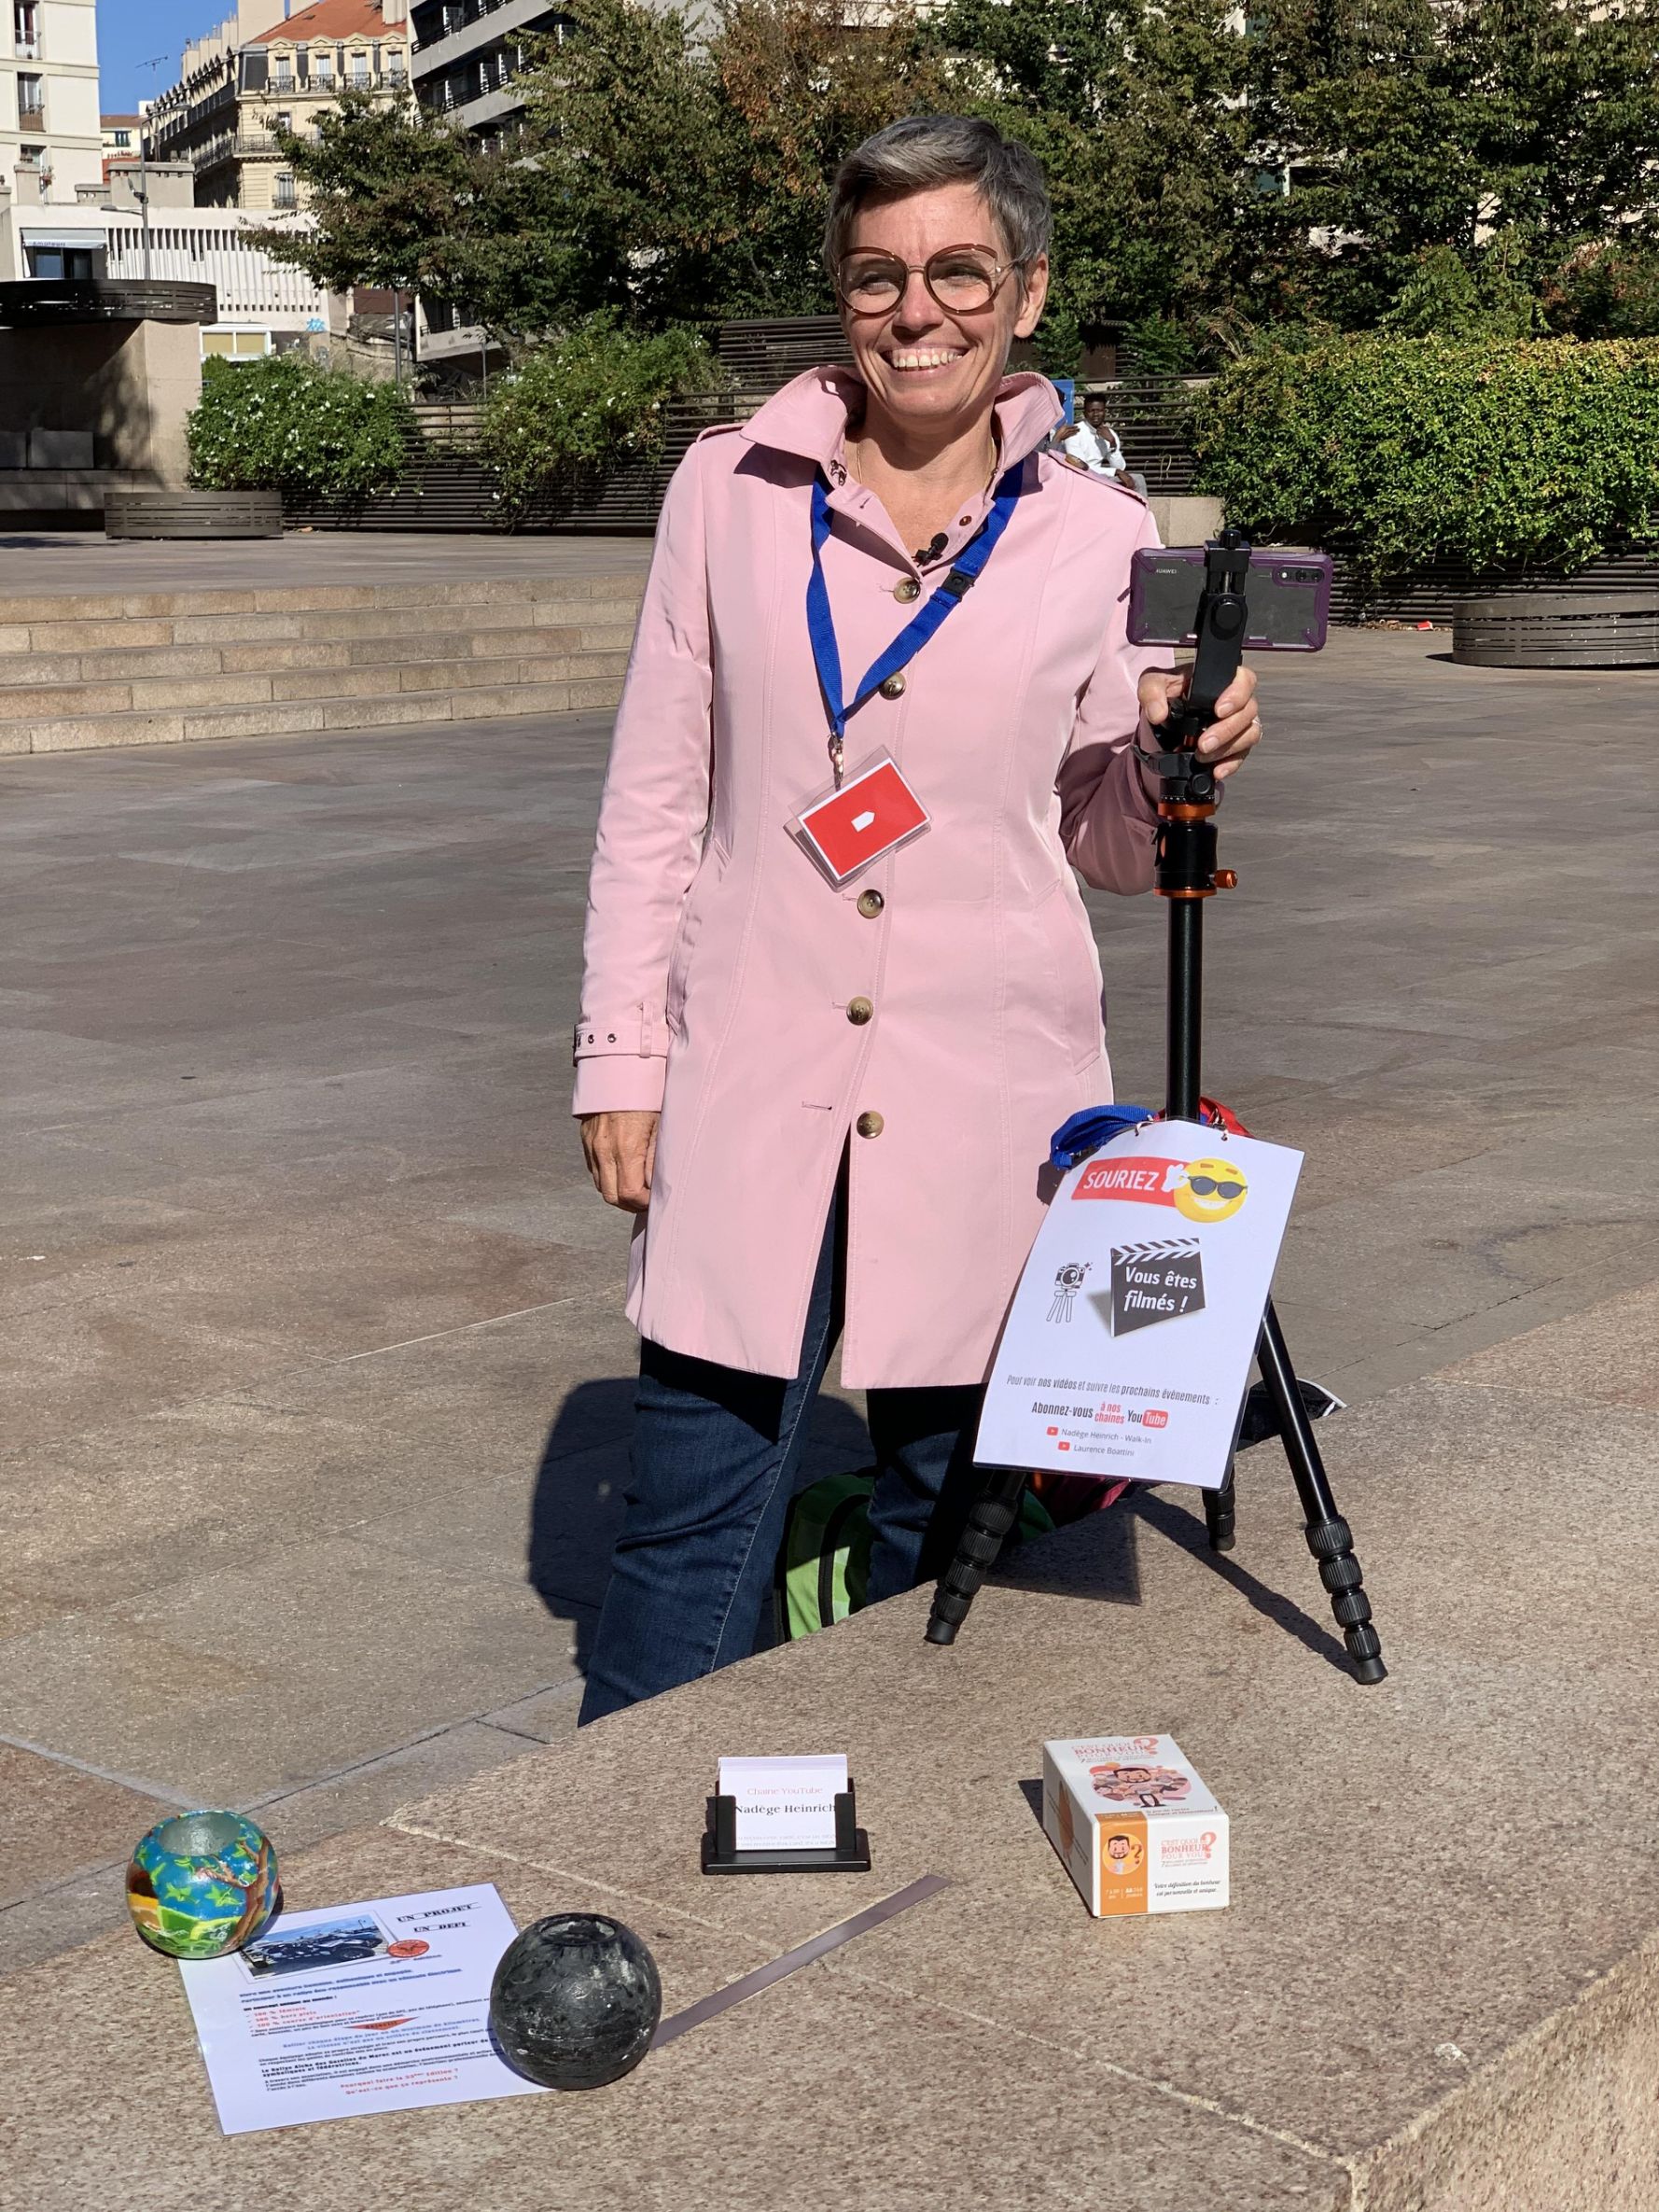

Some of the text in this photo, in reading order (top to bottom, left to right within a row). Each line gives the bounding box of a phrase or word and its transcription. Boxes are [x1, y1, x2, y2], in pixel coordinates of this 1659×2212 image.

[1083, 1169, 1159, 1192] SOURIEZ
[1125, 1266, 1197, 1290] Vous êtes
[1123, 1290, 1188, 1313] filmés !
[1007, 1375, 1023, 1386] Pour
[1024, 1376, 1037, 1387] voir
[1038, 1378, 1053, 1388] nos
[1053, 1378, 1077, 1390] vidéos
[1078, 1381, 1086, 1391] et
[1086, 1381, 1108, 1393] suivre
[1108, 1382, 1120, 1393] les
[1121, 1385, 1161, 1398] prochains
[1031, 1402, 1094, 1418] Abonnez-vous
[1100, 1401, 1122, 1413] à nos
[1062, 1428, 1089, 1439] Nadège
[1090, 1432, 1119, 1440] Heinrich
[1074, 1445, 1135, 1456] Laurence Boattini
[781, 1786, 823, 1795] YouTube
[1161, 1844, 1207, 1854] BONHEUR
[397, 1904, 472, 1923] UN PROJET
